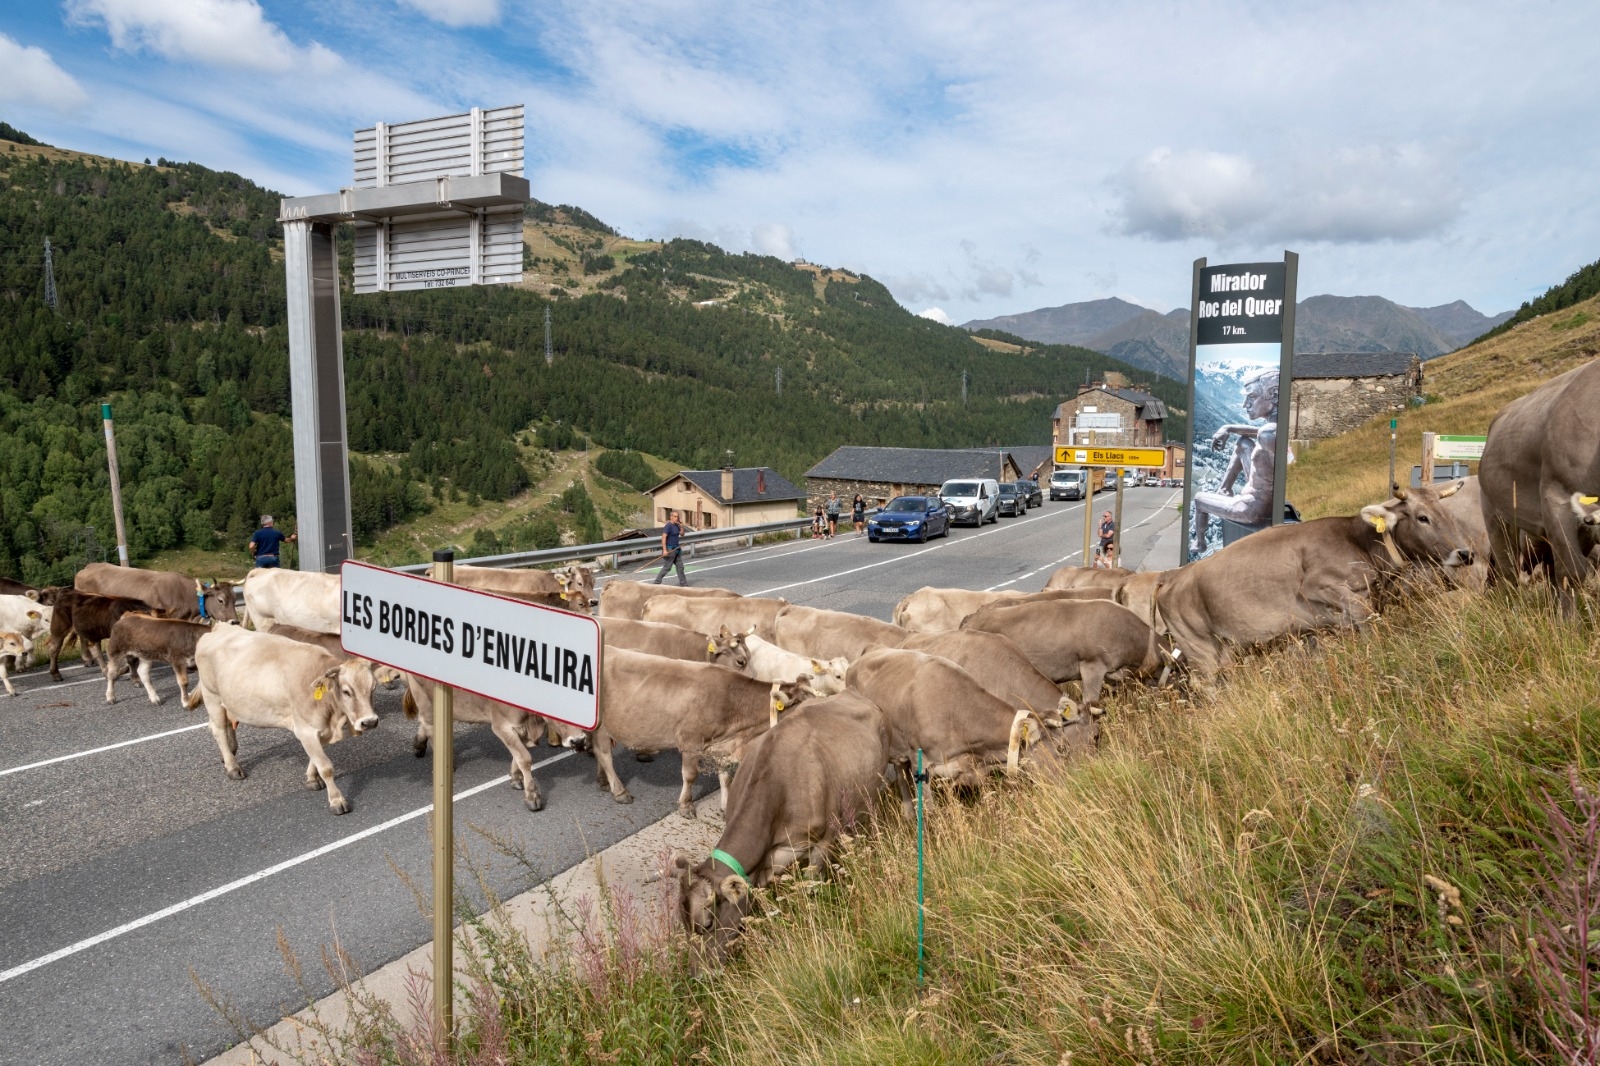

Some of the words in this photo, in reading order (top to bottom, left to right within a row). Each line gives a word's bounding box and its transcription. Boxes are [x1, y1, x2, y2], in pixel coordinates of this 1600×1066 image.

[435, 279, 445, 287] 732
[1211, 272, 1267, 292] Mirador
[1199, 300, 1220, 319] Roc
[1221, 299, 1243, 317] del
[1245, 296, 1282, 318] Quer
[1222, 325, 1231, 336] 17
[1232, 325, 1247, 335] km.
[1093, 451, 1104, 459] Els
[1105, 452, 1124, 460] Llacs
[343, 590, 373, 630] LES
[379, 600, 454, 654] BORDES
[462, 622, 594, 696] D'ENVALIRA
